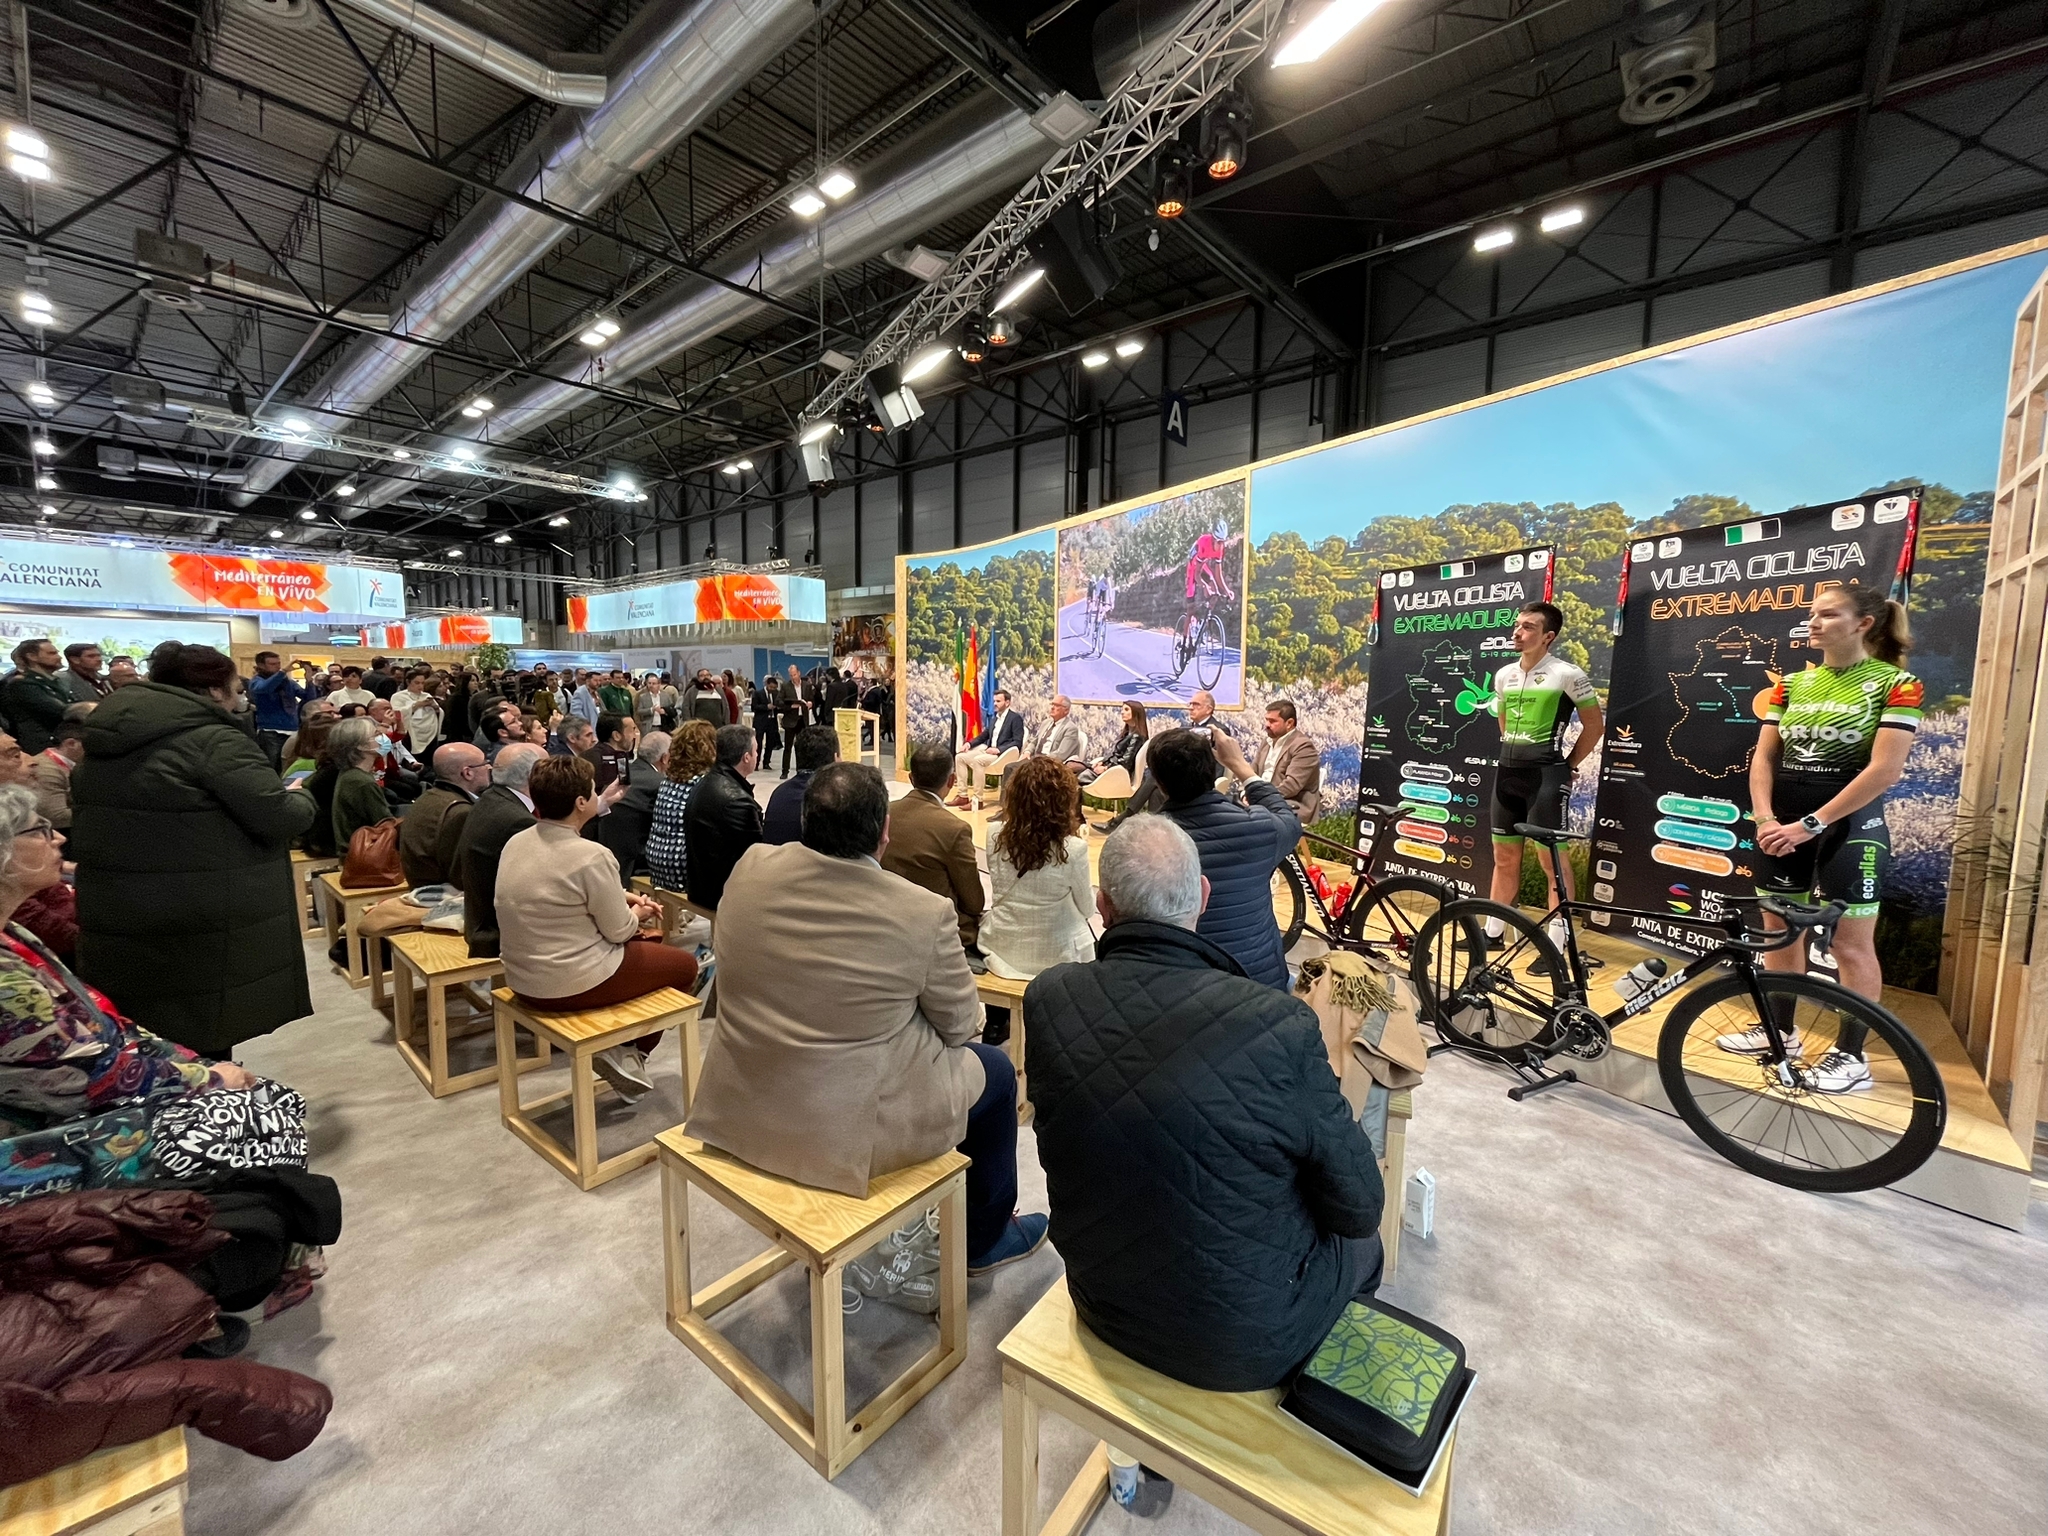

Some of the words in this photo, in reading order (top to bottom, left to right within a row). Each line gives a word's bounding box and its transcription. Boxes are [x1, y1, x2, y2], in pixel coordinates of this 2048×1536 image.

[1167, 400, 1184, 438] A
[8, 562, 100, 577] COMUNITAT
[1650, 559, 1742, 591] VUELTA
[1746, 541, 1866, 580] CICLISTA
[0, 573, 102, 588] ALENCIANA
[214, 569, 311, 585] Mediterráneo
[257, 585, 274, 597] EN
[405, 586, 416, 598] A
[1393, 589, 1452, 612] VUELTA
[1454, 580, 1525, 606] CICLISTA
[1651, 577, 1860, 620] EXTREMADU
[1480, 636, 1516, 650] 202
[1560, 795, 1568, 831] xtremadura
[1384, 860, 1405, 875] JUNTA
[1858, 845, 1878, 900] ecopilas
[1701, 889, 1724, 903] UC
[1631, 917, 1662, 935] JUNTA
[1667, 926, 1682, 940] DE
